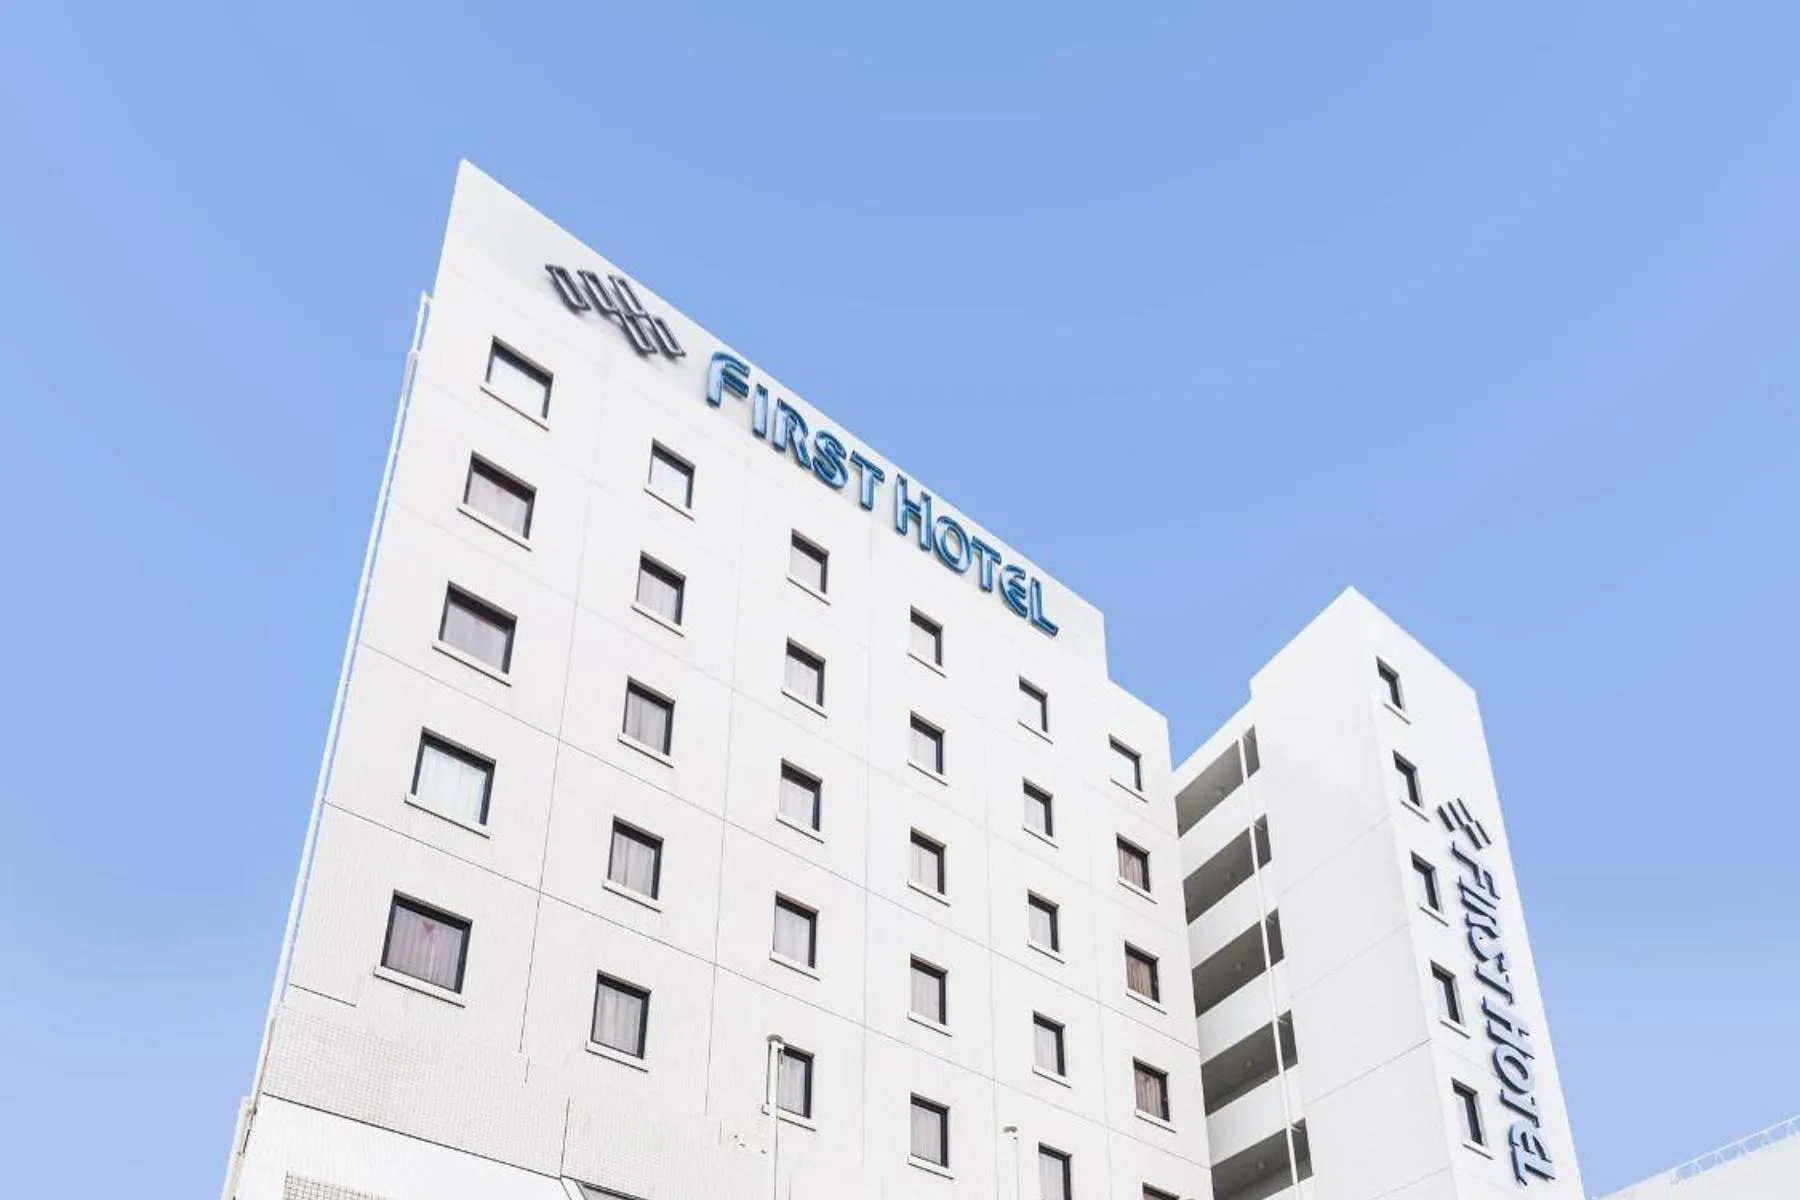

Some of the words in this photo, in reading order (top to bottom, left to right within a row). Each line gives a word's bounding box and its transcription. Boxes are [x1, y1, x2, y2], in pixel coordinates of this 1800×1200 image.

[705, 350, 885, 511] FIRST
[894, 472, 1059, 638] HOTEL
[1451, 840, 1516, 1005] FIRST
[1481, 996, 1556, 1187] HOTEL
